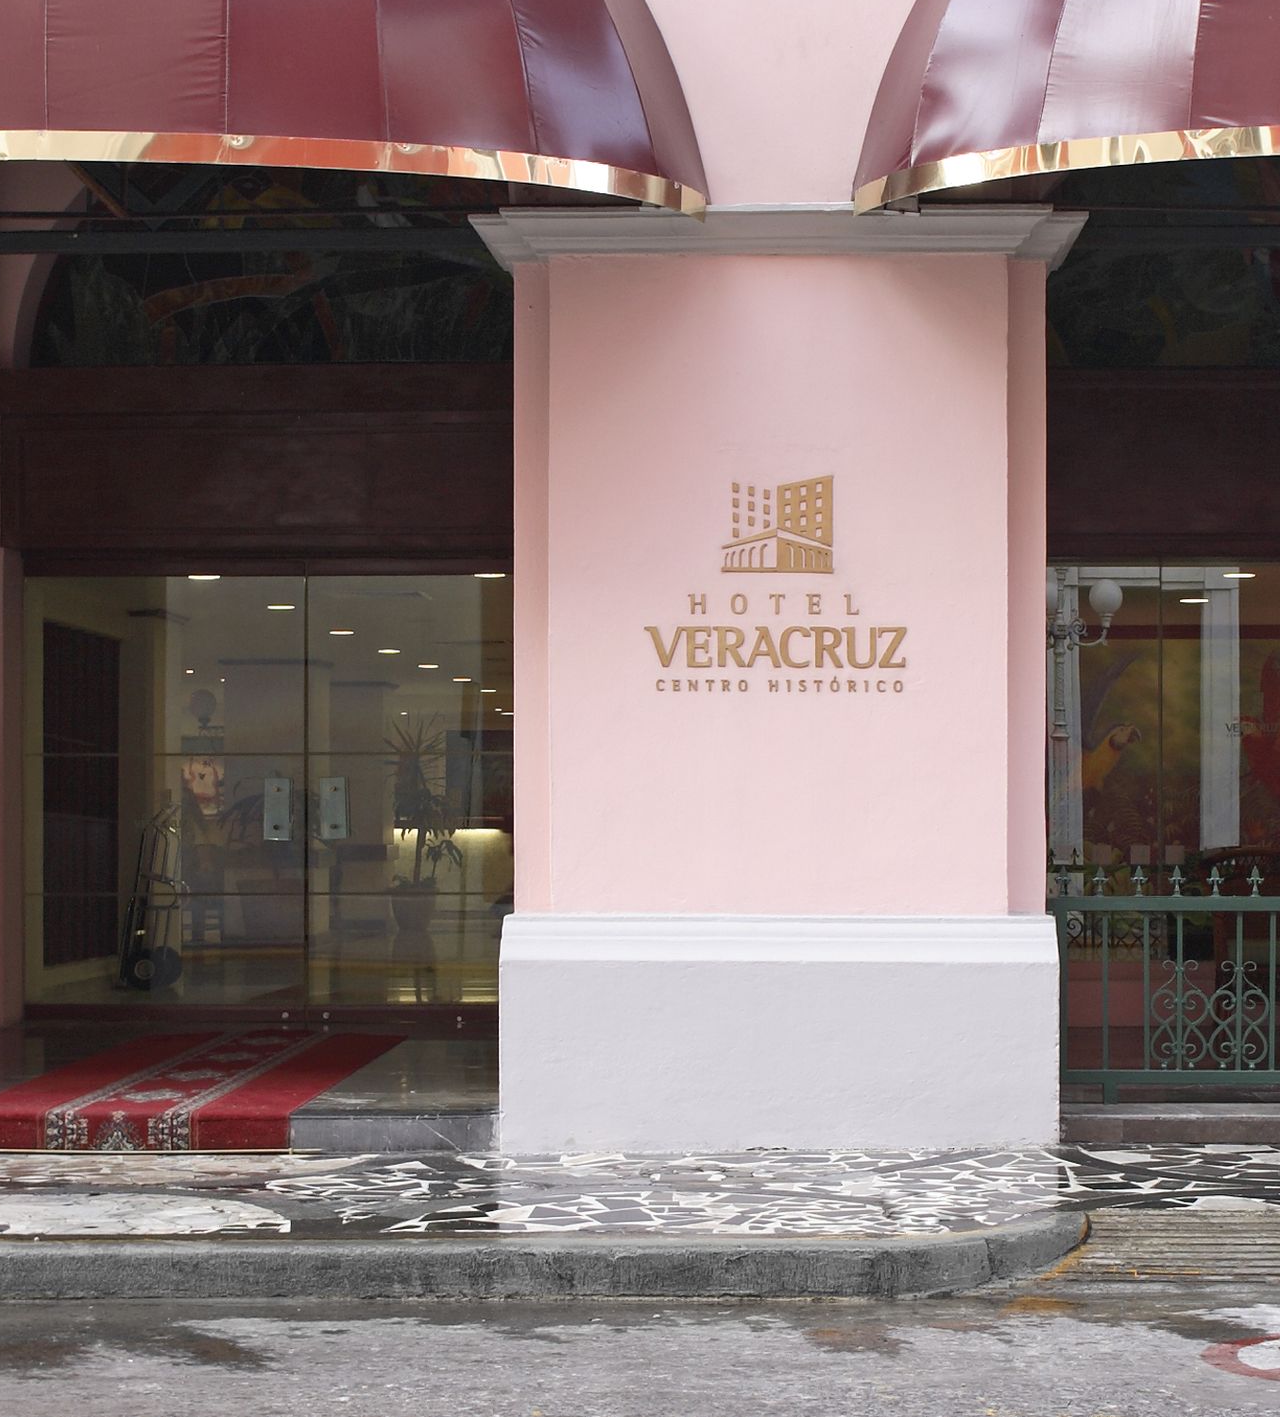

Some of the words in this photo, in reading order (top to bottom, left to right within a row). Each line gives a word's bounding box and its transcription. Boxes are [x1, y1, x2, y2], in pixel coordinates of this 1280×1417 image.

[688, 593, 859, 615] HOTEL
[644, 626, 907, 669] VERACRUZ
[655, 679, 749, 693] CENTRO
[768, 676, 905, 693] HISTÓRICO
